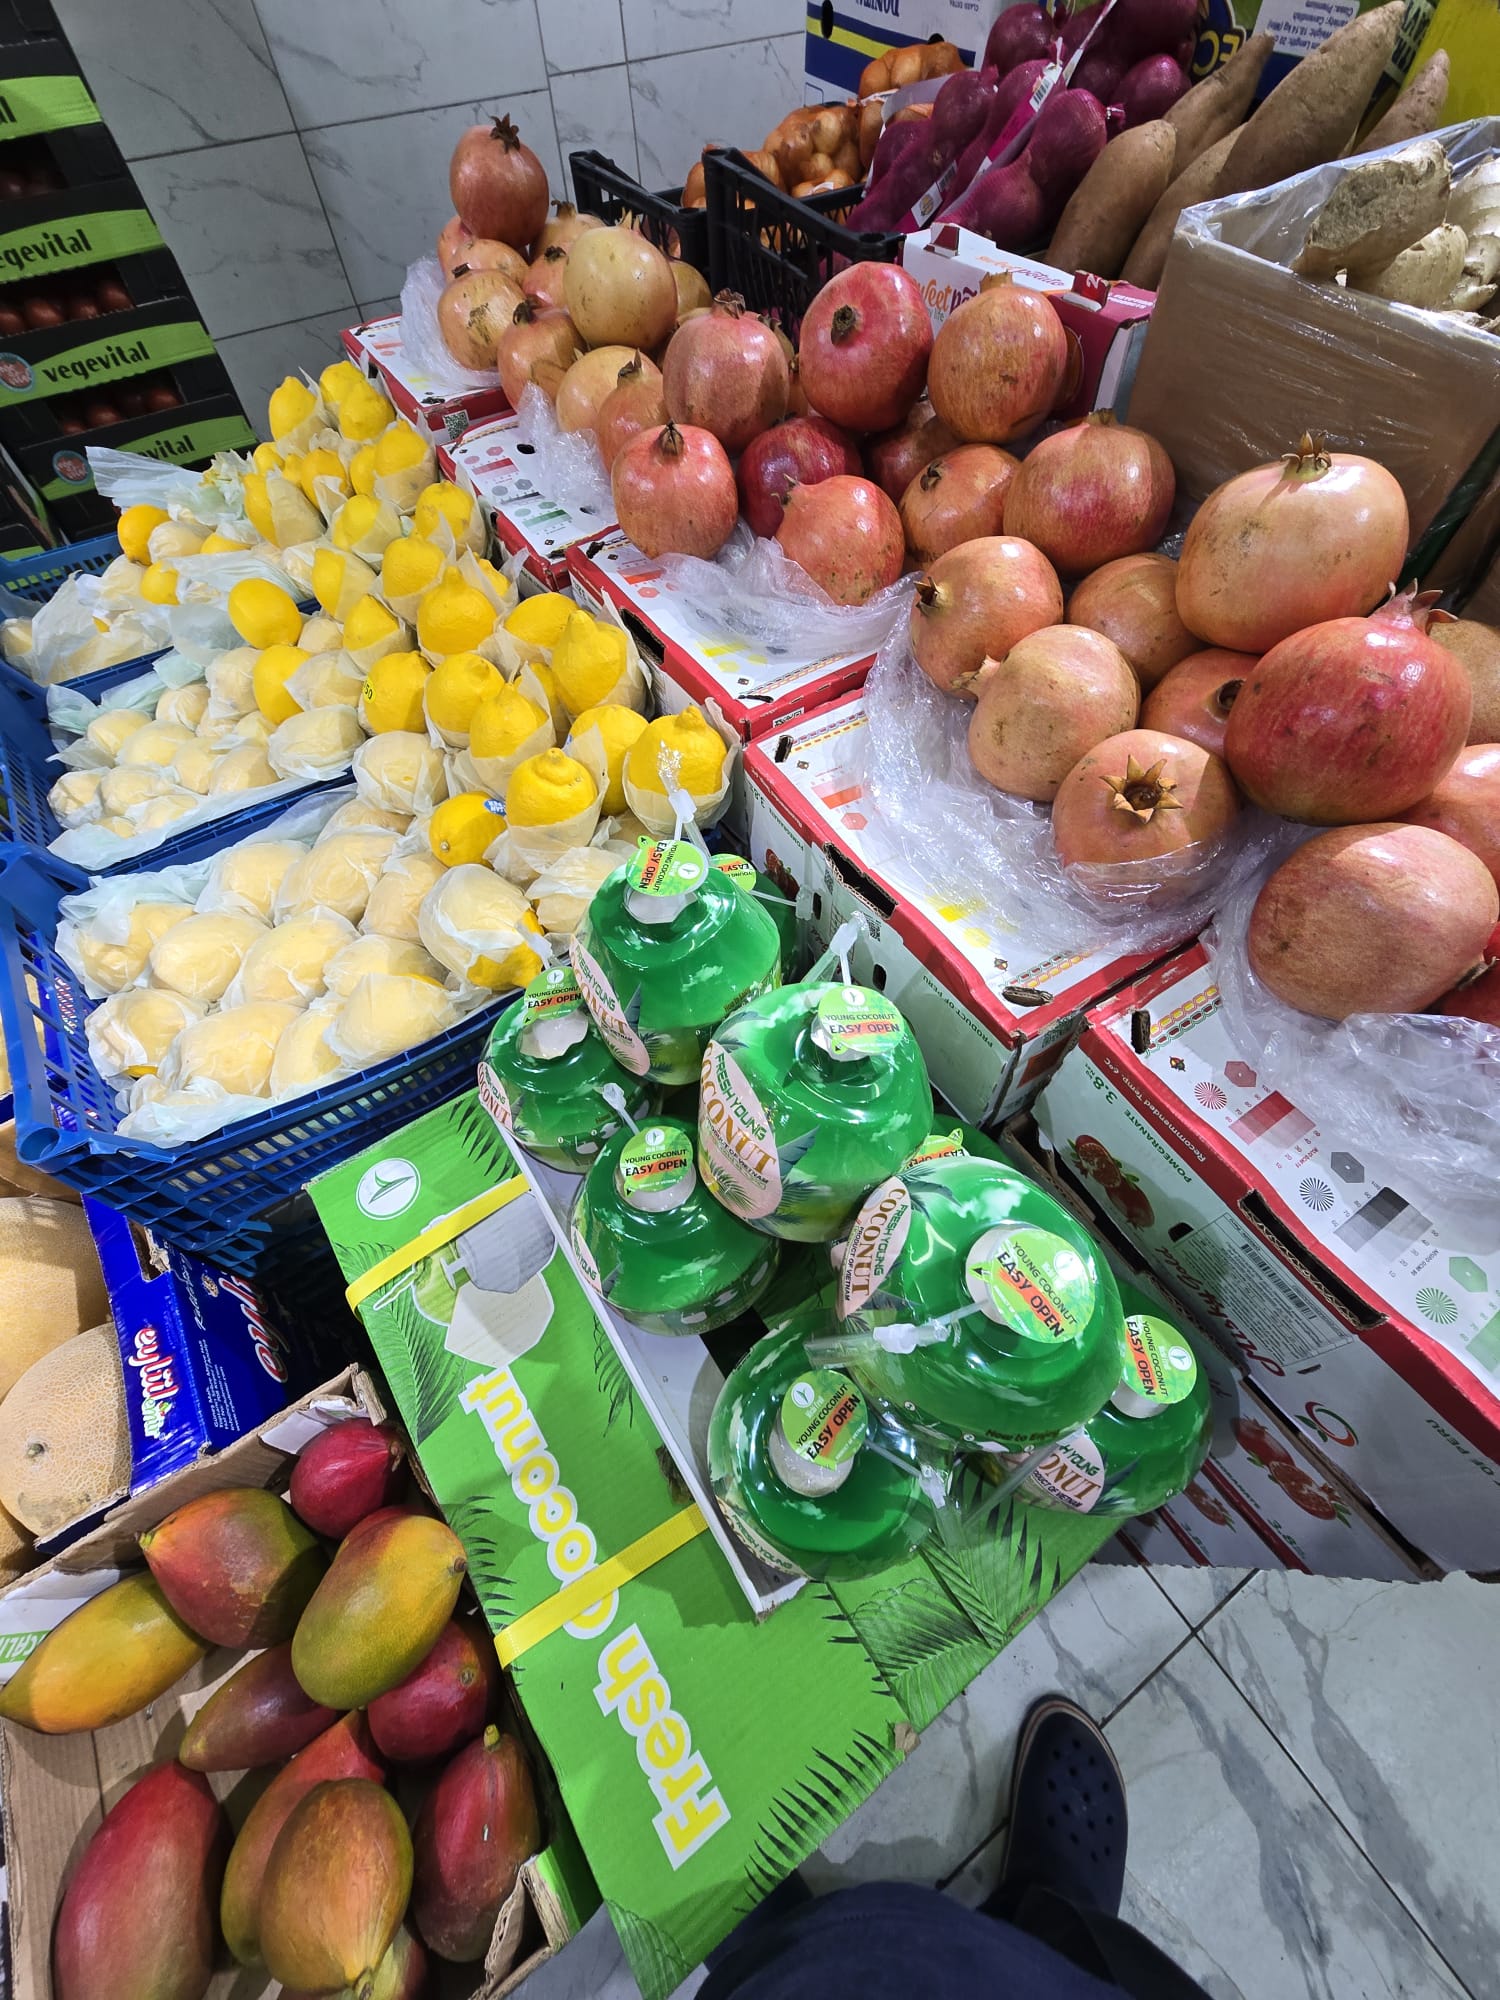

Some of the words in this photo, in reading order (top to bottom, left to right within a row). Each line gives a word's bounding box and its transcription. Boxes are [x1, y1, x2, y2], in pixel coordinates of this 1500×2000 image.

[0, 228, 92, 272] gevital
[42, 340, 151, 383] vegevital
[143, 434, 195, 460] vital
[650, 841, 667, 864] EASY
[665, 844, 678, 862] YOUNG
[727, 863, 750, 871] EASY
[638, 866, 656, 889] OPEN
[653, 862, 668, 892] COCONUT
[527, 998, 553, 1009] EASY
[556, 993, 582, 1003] OPEN
[528, 991, 550, 999] YOUNG
[592, 979, 616, 1011] YOUNG
[921, 975, 944, 997] PERU
[825, 1013, 855, 1021] YOUNG
[943, 997, 955, 1009] OF
[830, 1023, 861, 1034] EASY
[867, 1023, 900, 1033] OPEN
[954, 1008, 994, 1048] PRODUCT
[714, 1053, 737, 1102] FRESH
[729, 1097, 767, 1141] YOUNG
[1090, 1074, 1119, 1105] 3.8
[1119, 1072, 1144, 1101] Temp.
[1122, 1108, 1192, 1183] POMEGRANATE
[1142, 1098, 1206, 1163] Recommended
[624, 1154, 651, 1164] YOUNG
[652, 1149, 687, 1160] COCONUT
[625, 1165, 655, 1177] EASY
[657, 1158, 688, 1171] OPEN
[737, 1155, 769, 1185] VIETNAM
[888, 1203, 908, 1235] FRESH
[852, 1188, 906, 1297] COCONUT
[873, 1233, 890, 1277] YOUNG
[843, 1265, 853, 1301] VIETNAM
[996, 1252, 1032, 1291] EASY
[1030, 1295, 1065, 1338] OPEN
[1013, 1242, 1039, 1279] YOUNG
[1038, 1278, 1078, 1325] COCONUT
[1143, 1321, 1156, 1350] YOUNG
[1126, 1321, 1145, 1354] EASY
[1138, 1360, 1156, 1396] OPEN
[1149, 1350, 1168, 1397] COCONUT
[796, 1420, 821, 1447] YOUNG
[818, 1384, 848, 1423] COCONUT
[806, 1427, 833, 1460] EASY
[832, 1394, 861, 1427] OPEN
[1424, 1417, 1470, 1457] PERU
[1039, 1453, 1101, 1500] ONUT
[1068, 1446, 1100, 1477] YOUNG
[1468, 1456, 1495, 1478] OF
[598, 1627, 728, 1864] Fresh
